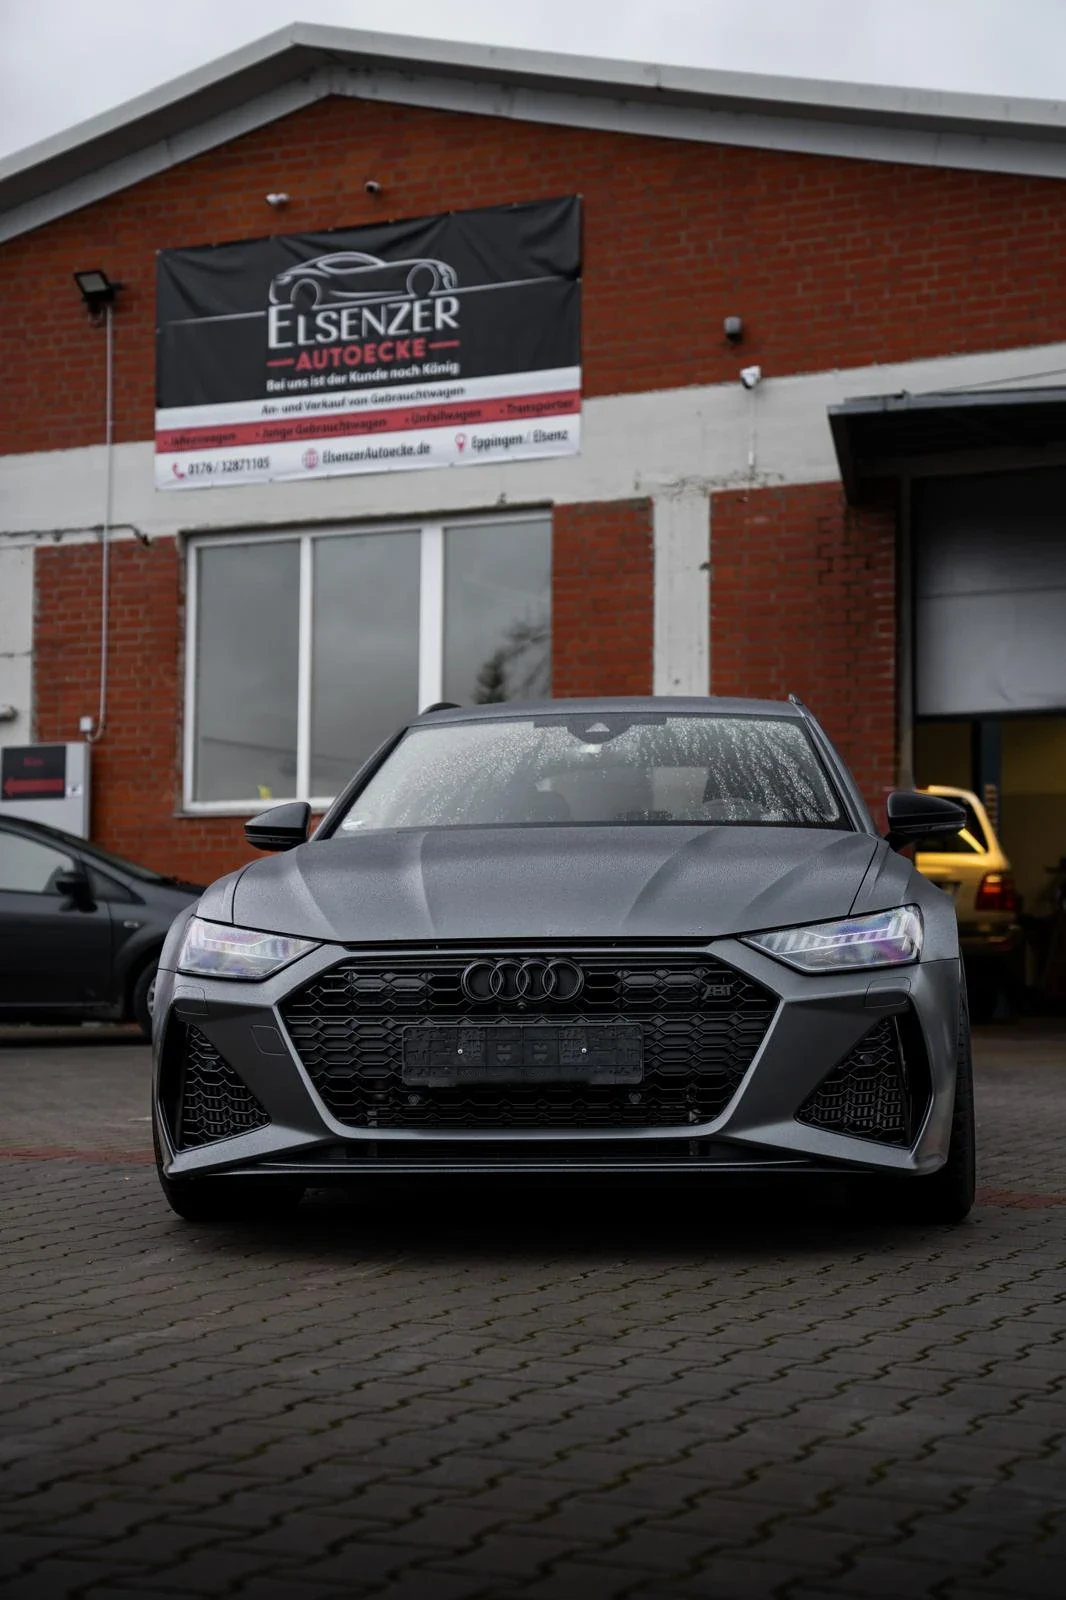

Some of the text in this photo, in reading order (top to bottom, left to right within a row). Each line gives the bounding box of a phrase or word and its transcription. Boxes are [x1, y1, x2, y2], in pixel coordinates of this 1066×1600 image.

[268, 296, 460, 349] ELSENZER
[295, 338, 426, 371] AUTOECKE
[266, 361, 460, 392] Bei uns ist der Kunde nach König
[281, 401, 301, 413] und
[304, 398, 345, 411] Verkauf
[349, 397, 368, 407] von
[370, 387, 465, 404] Gebrauchtwagen
[295, 417, 387, 434] Gebrauchtwagen
[411, 407, 482, 424] Unfallwagen
[322, 440, 430, 464] ElsenzerAutoecke.de
[471, 433, 523, 452] Eppingen
[533, 429, 568, 443] Elsenz
